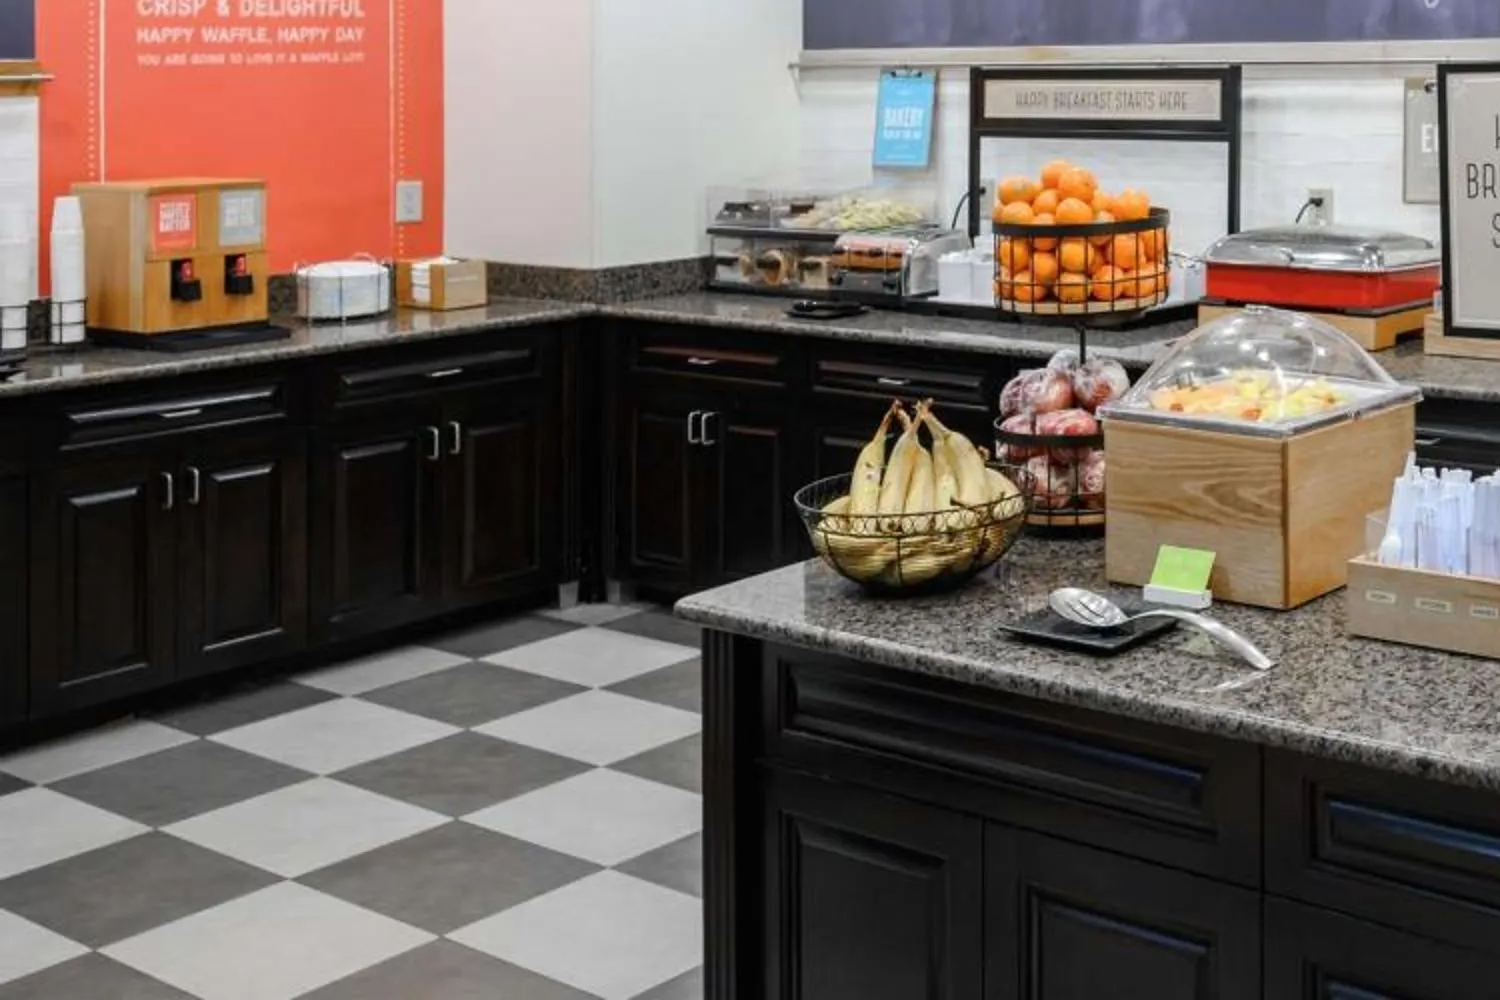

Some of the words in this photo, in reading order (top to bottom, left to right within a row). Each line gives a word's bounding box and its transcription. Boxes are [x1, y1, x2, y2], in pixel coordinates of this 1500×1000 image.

[137, 26, 193, 44] HAPPY
[278, 26, 328, 43] HAPPY
[336, 26, 364, 43] DAY
[1015, 90, 1048, 109] HAPPY
[1053, 90, 1112, 111] BREAKFAST
[1115, 90, 1155, 111] STARTS
[1159, 91, 1188, 111] HERE
